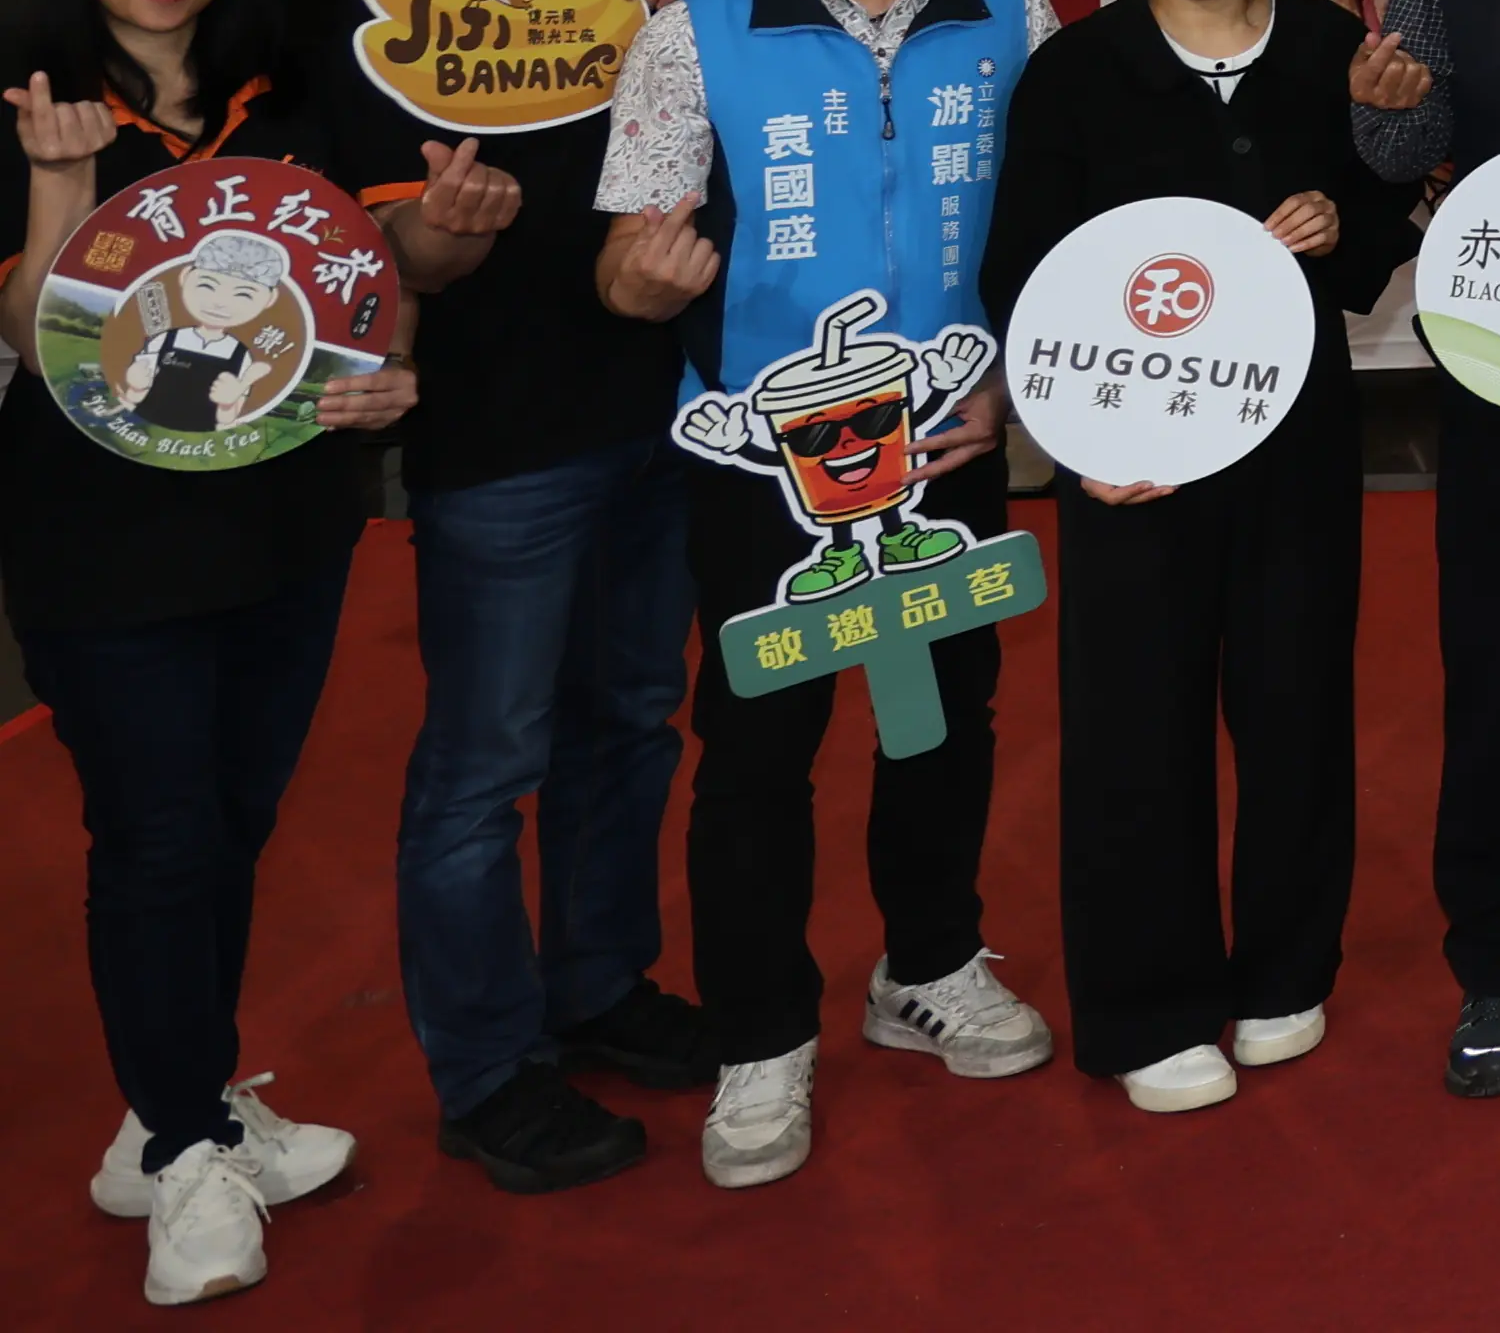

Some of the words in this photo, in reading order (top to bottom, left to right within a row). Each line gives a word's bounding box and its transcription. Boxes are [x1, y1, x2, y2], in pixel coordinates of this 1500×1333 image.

[527, 28, 597, 45] 觀光工廠
[435, 45, 622, 97] BANANA
[822, 88, 849, 135] 主任
[927, 83, 975, 186] 游顥
[975, 81, 996, 181] 立法委員
[762, 114, 818, 261] 袁國盛
[940, 195, 960, 292] 服務團隊
[1027, 337, 1281, 395] HUGOSUM
[1020, 372, 1270, 426] 和菓森林
[156, 437, 217, 457] Black
[224, 429, 261, 453] Tea
[754, 561, 1020, 671] 敬邀品茗
